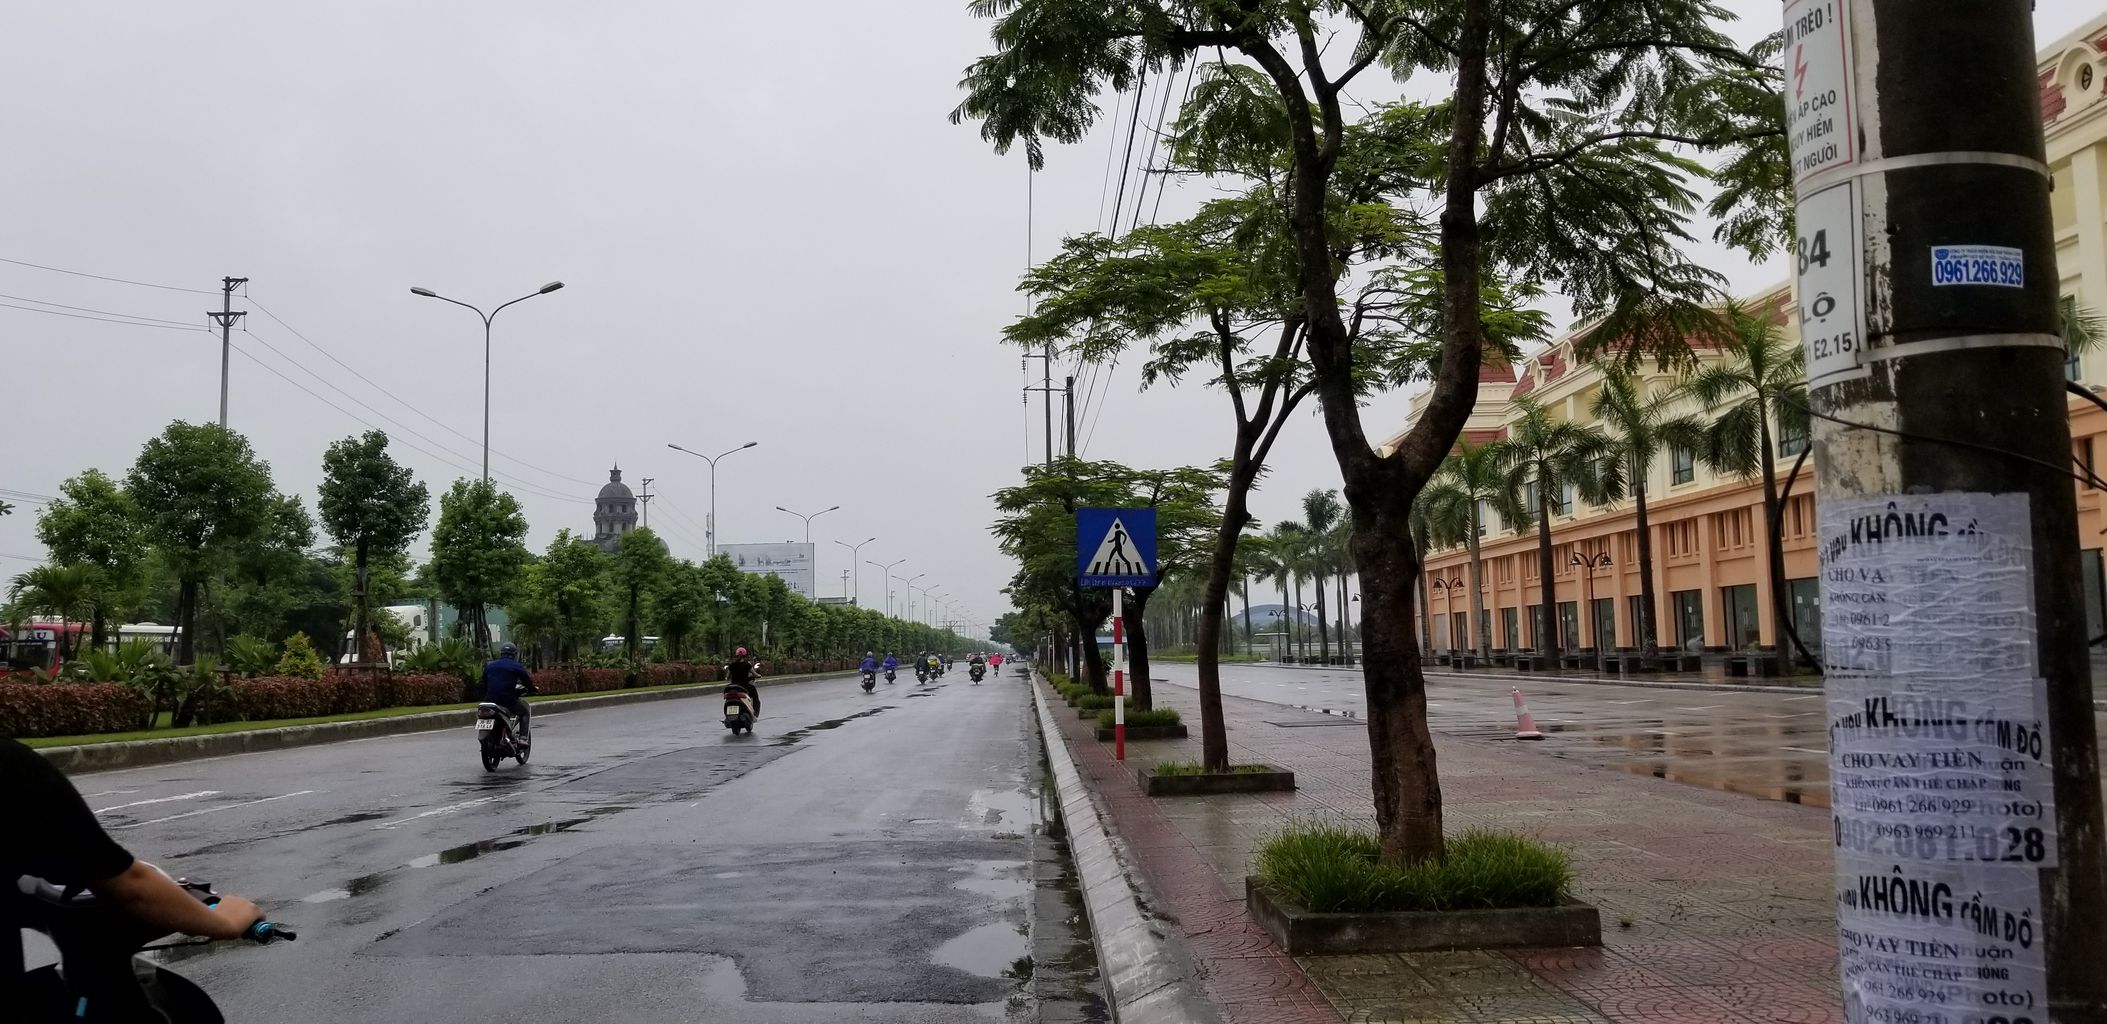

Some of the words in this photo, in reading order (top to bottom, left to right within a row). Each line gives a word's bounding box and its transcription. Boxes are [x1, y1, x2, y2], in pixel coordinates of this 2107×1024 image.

[1795, 8, 1823, 40] TRÈO
[1812, 89, 1837, 112] CAO
[1806, 112, 1833, 142] HIỂM
[1803, 142, 1838, 171] NGƯỜI
[1802, 291, 1836, 325] LỘ
[1814, 332, 1852, 361] E2.15
[1851, 501, 1949, 545] KHÔNG
[1828, 567, 1854, 582] CHO
[1842, 753, 1873, 768] CHO
[1878, 752, 1917, 768] VAY
[1872, 799, 1903, 813] 0961
[1909, 799, 1937, 813] 266
[1942, 799, 1971, 813] 929
[1914, 823, 1943, 839] 969
[1860, 864, 1953, 918] KHÔNG
[1961, 890, 1999, 938] CẦM
[2004, 907, 2033, 949] ĐỒ
[1864, 933, 1899, 954] VAY
